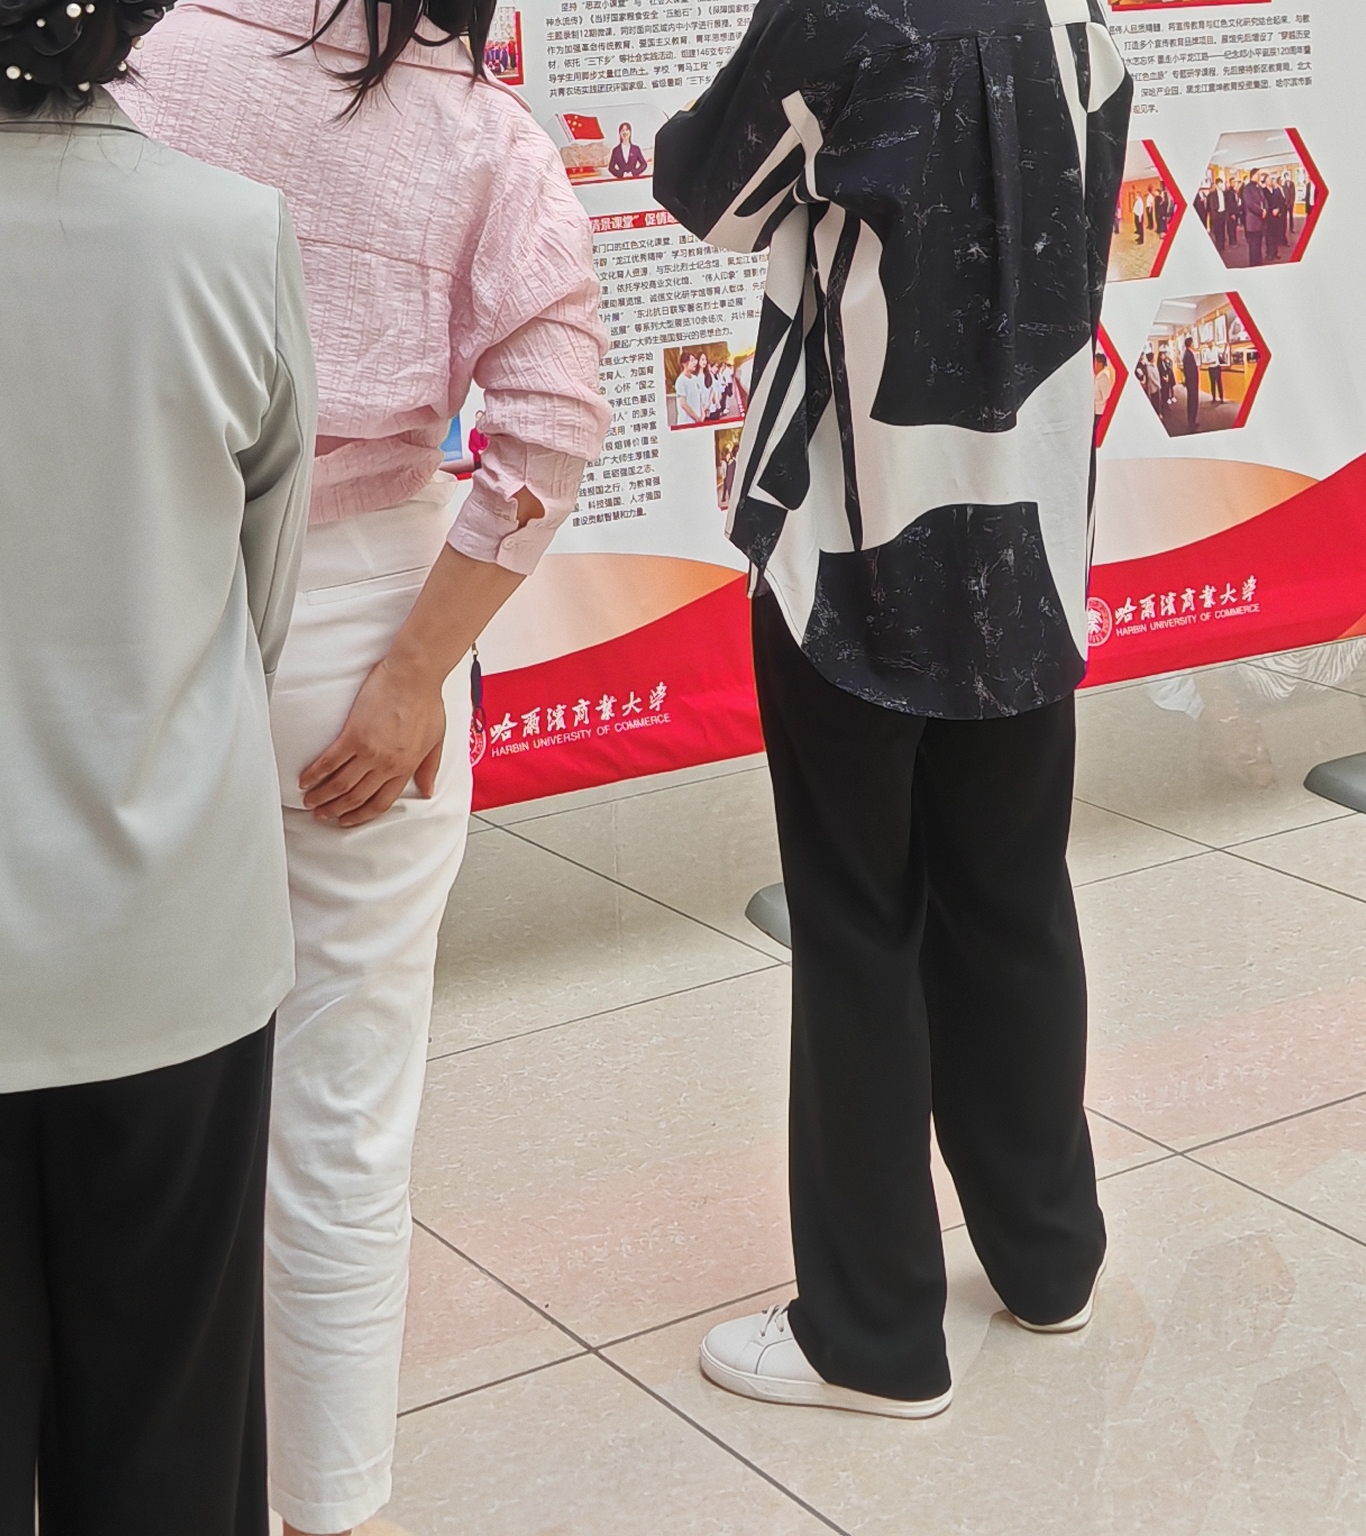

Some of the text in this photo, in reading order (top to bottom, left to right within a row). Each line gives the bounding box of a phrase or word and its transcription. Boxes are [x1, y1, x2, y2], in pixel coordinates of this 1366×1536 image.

[1116, 603, 1261, 637] HARBIN UNIVERSITY OF COMMERCE
[491, 713, 672, 757] HARBIN UNIVERSITY OF COMMERCE
